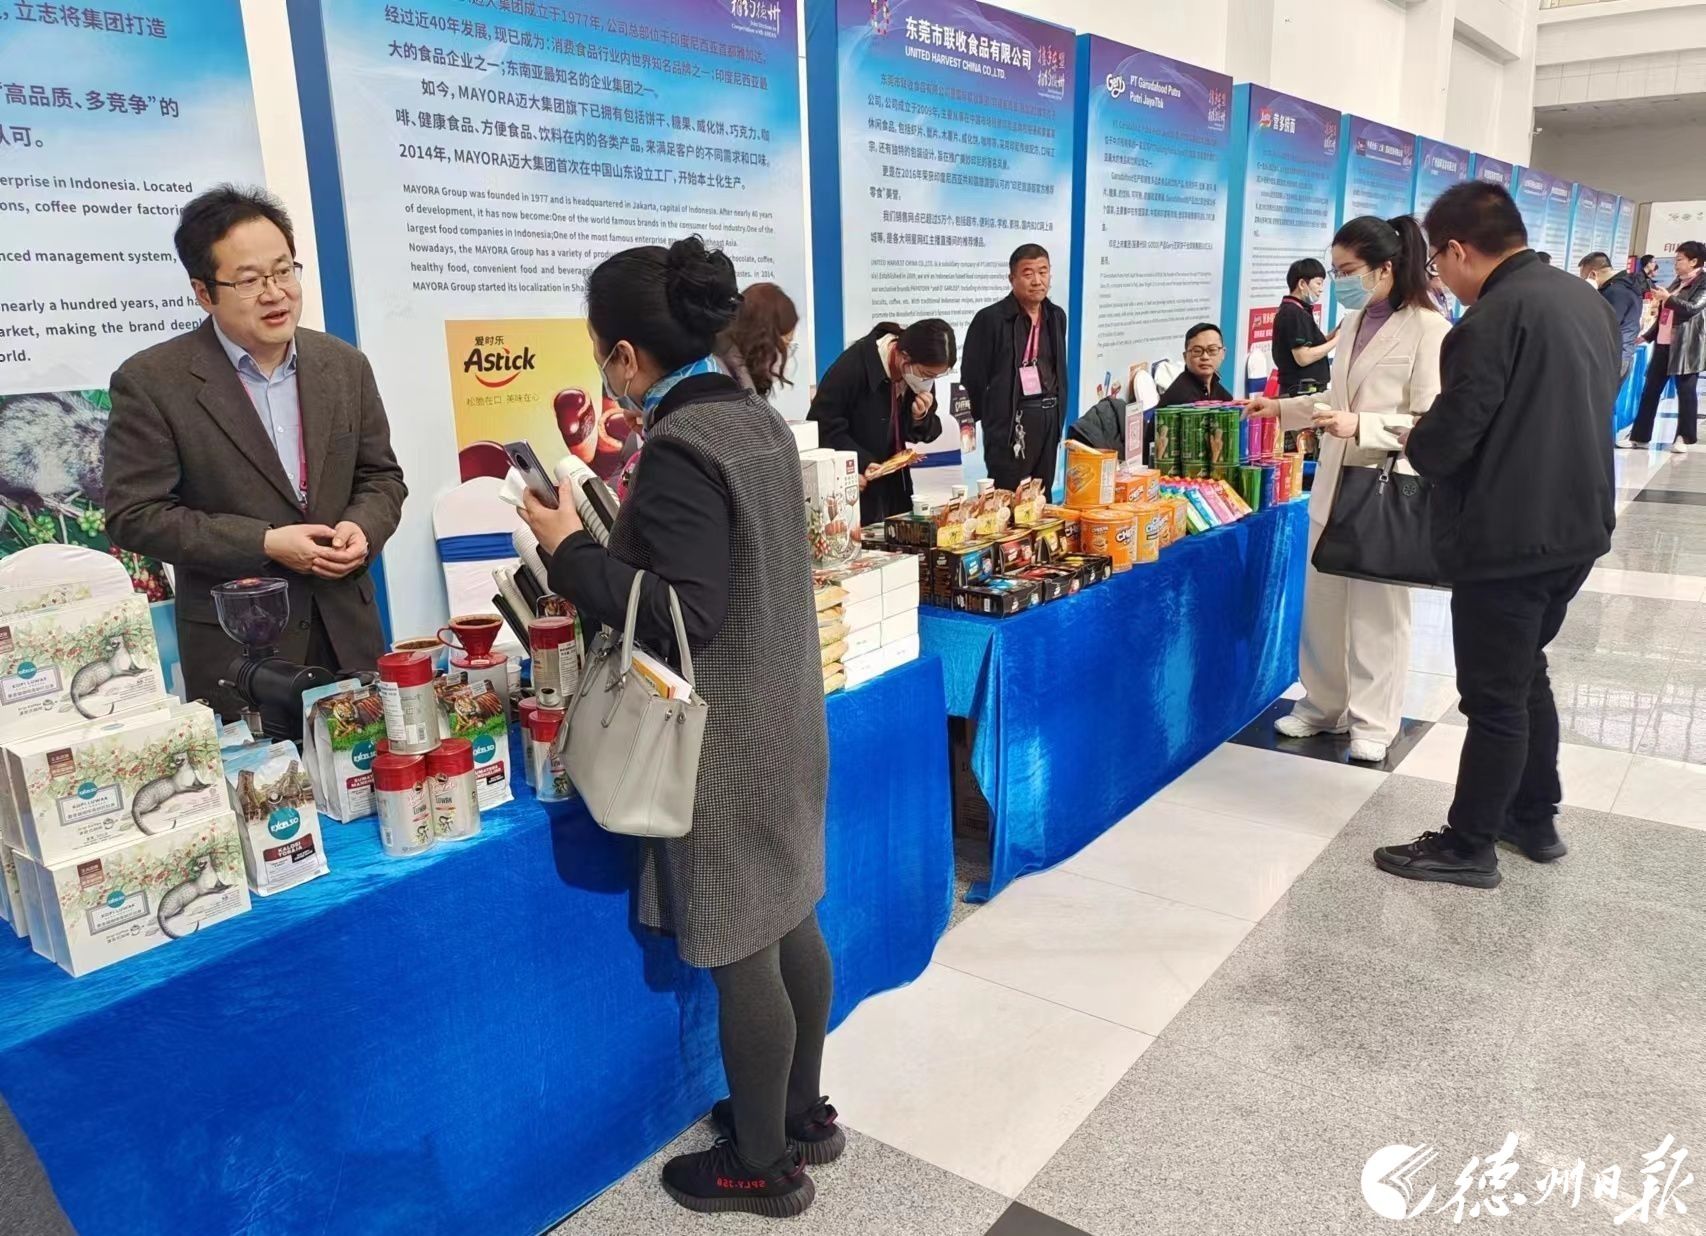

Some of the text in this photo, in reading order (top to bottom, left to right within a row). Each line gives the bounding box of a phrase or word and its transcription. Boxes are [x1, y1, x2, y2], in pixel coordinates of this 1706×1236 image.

[0, 0, 167, 38] ，立志将集团打造
[905, 16, 1032, 70] 东莞市联收食品有限公司
[905, 46, 930, 61] UNITED
[932, 52, 961, 69] HARVEST
[962, 60, 981, 74] CHINA
[1130, 75, 1137, 86] PT
[53, 175, 66, 188] in
[70, 177, 139, 191] Indonesia.
[143, 180, 192, 192] Located
[34, 200, 76, 212] coffee
[82, 202, 132, 215] powder
[402, 184, 440, 196] MAYORA
[441, 186, 468, 199] Group
[468, 190, 486, 198] was
[486, 189, 520, 201] founded
[521, 192, 529, 201] in
[530, 192, 548, 203] 1977
[549, 195, 564, 204] and
[565, 195, 572, 205] is
[572, 196, 623, 208] headquartered
[624, 199, 631, 208] in
[632, 200, 658, 212] Jakarta,
[659, 204, 680, 213] capital
[681, 204, 688, 212] of
[688, 205, 718, 215] Indonesia.
[719, 207, 732, 216] After
[733, 209, 750, 219] nearly
[404, 202, 414, 213] of
[415, 204, 475, 218] development,
[477, 207, 484, 217] it
[484, 207, 500, 218] has
[501, 211, 518, 219] now
[519, 210, 567, 222] become:One
[567, 213, 576, 224] of
[576, 213, 589, 223] the
[589, 215, 610, 224] world
[611, 216, 636, 226] famous
[636, 217, 659, 227] brands
[660, 218, 667, 228] in
[667, 220, 678, 228] the
[678, 222, 708, 234] consumer
[708, 222, 722, 231] food
[722, 223, 757, 233] industry.One
[764, 225, 773, 233] the
[406, 222, 437, 235] largest
[438, 223, 458, 237] food
[459, 226, 504, 237] companies
[504, 227, 513, 237] in
[513, 228, 568, 240] Indonesia;One
[569, 231, 576, 240] of
[577, 231, 589, 240] the
[590, 233, 608, 241] most
[608, 232, 633, 242] famous
[634, 236, 666, 246] enterprise
[35, 252, 124, 264] management
[128, 248, 176, 264] system,
[408, 242, 456, 255] Nowadays,
[458, 243, 472, 254] the
[474, 245, 509, 255] MAYORA
[510, 246, 534, 257] Group
[535, 247, 549, 256] has
[557, 248, 582, 260] variety
[583, 248, 591, 258] of
[410, 261, 443, 274] healthy
[447, 262, 469, 274] food,
[472, 264, 517, 273] convenient
[520, 264, 538, 274] food
[540, 265, 555, 274] and
[412, 281, 449, 291] MAYORA
[450, 282, 476, 292] Group
[477, 282, 506, 292] started
[507, 282, 518, 292] its
[518, 282, 561, 292] localization
[562, 283, 570, 292] in
[0, 299, 45, 314] nearly
[49, 301, 57, 310] a
[60, 297, 117, 310] hundred
[120, 299, 158, 311] years,
[161, 295, 184, 307] and
[45, 322, 97, 337] making
[101, 321, 124, 333] the
[128, 319, 165, 332] brand
[475, 336, 505, 346] 爱时乐
[464, 346, 536, 372] Astick
